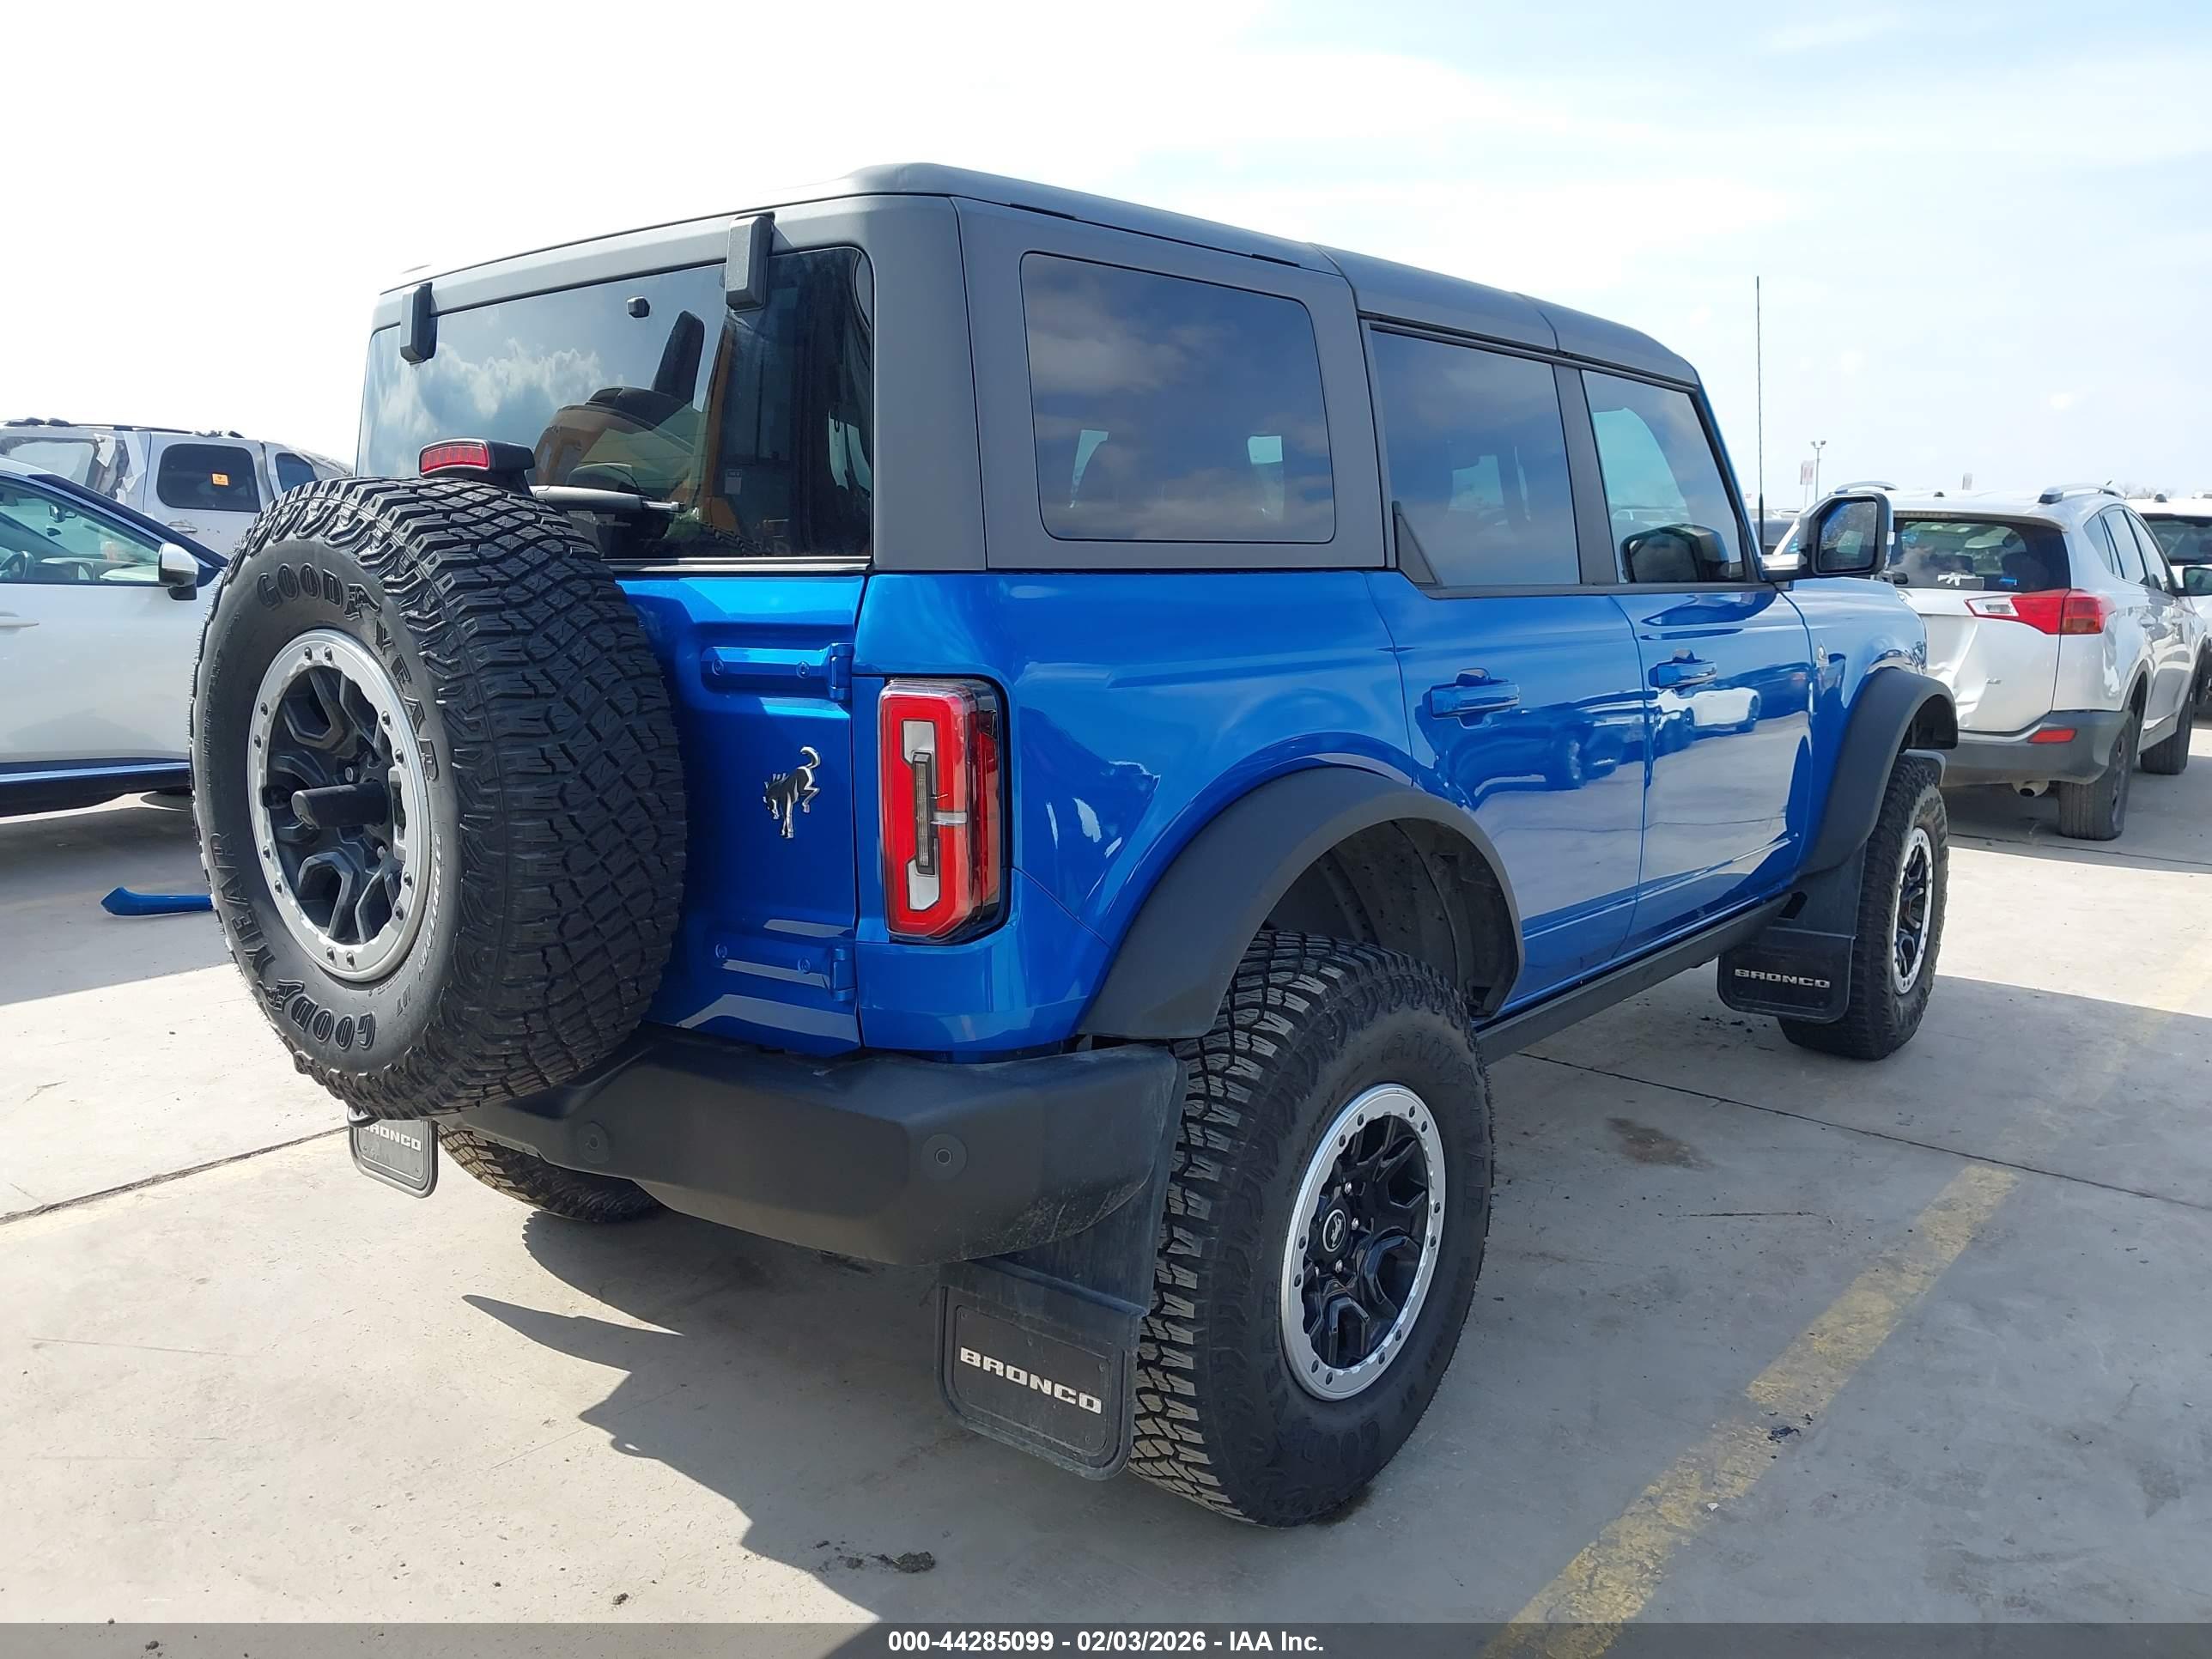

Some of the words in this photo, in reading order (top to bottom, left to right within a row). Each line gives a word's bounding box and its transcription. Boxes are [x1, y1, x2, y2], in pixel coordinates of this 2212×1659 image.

[256, 562, 441, 782] GOODYEAR
[210, 832, 377, 1051] GOODYEAR
[1735, 969, 1831, 989] BRONCO
[960, 1346, 1102, 1415] BRONCO
